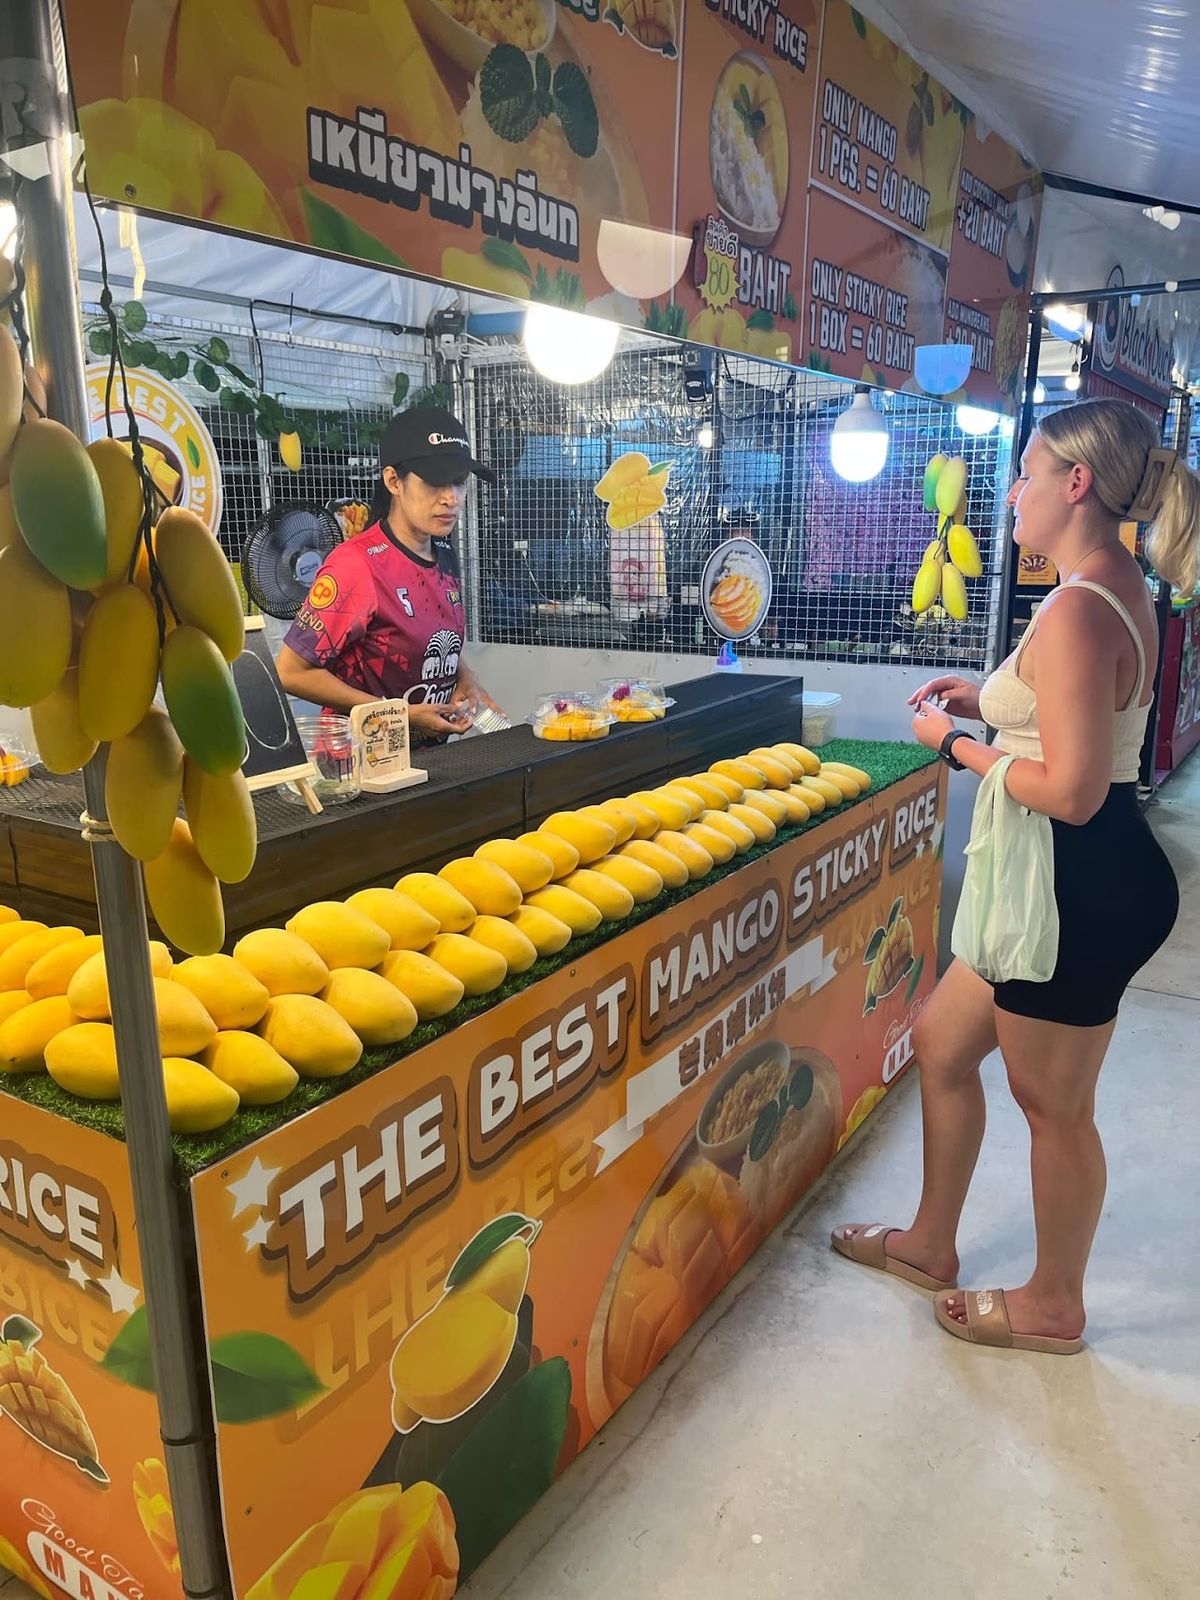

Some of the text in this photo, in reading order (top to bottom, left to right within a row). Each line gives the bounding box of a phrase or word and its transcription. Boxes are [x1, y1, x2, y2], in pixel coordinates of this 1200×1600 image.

[774, 13, 807, 67] RICE
[823, 79, 897, 164] ONLY MANGO
[819, 125, 827, 173] 1
[829, 132, 861, 193] PCS.
[881, 165, 898, 212] 60
[900, 176, 930, 230] BAHT
[980, 210, 1006, 257] BAHT
[710, 246, 792, 316] 80 BAHT
[812, 259, 908, 328] ONLY STICKY RICE
[810, 302, 817, 345] 1
[820, 306, 848, 354] BOX
[866, 323, 883, 363] 60
[885, 328, 915, 372] BAHT
[396, 588, 415, 617] 5
[280, 788, 937, 1260] THE BEST MANGO STICKY RICE
[888, 1034, 912, 1077] MA
[20, 1497, 97, 1565] Good
